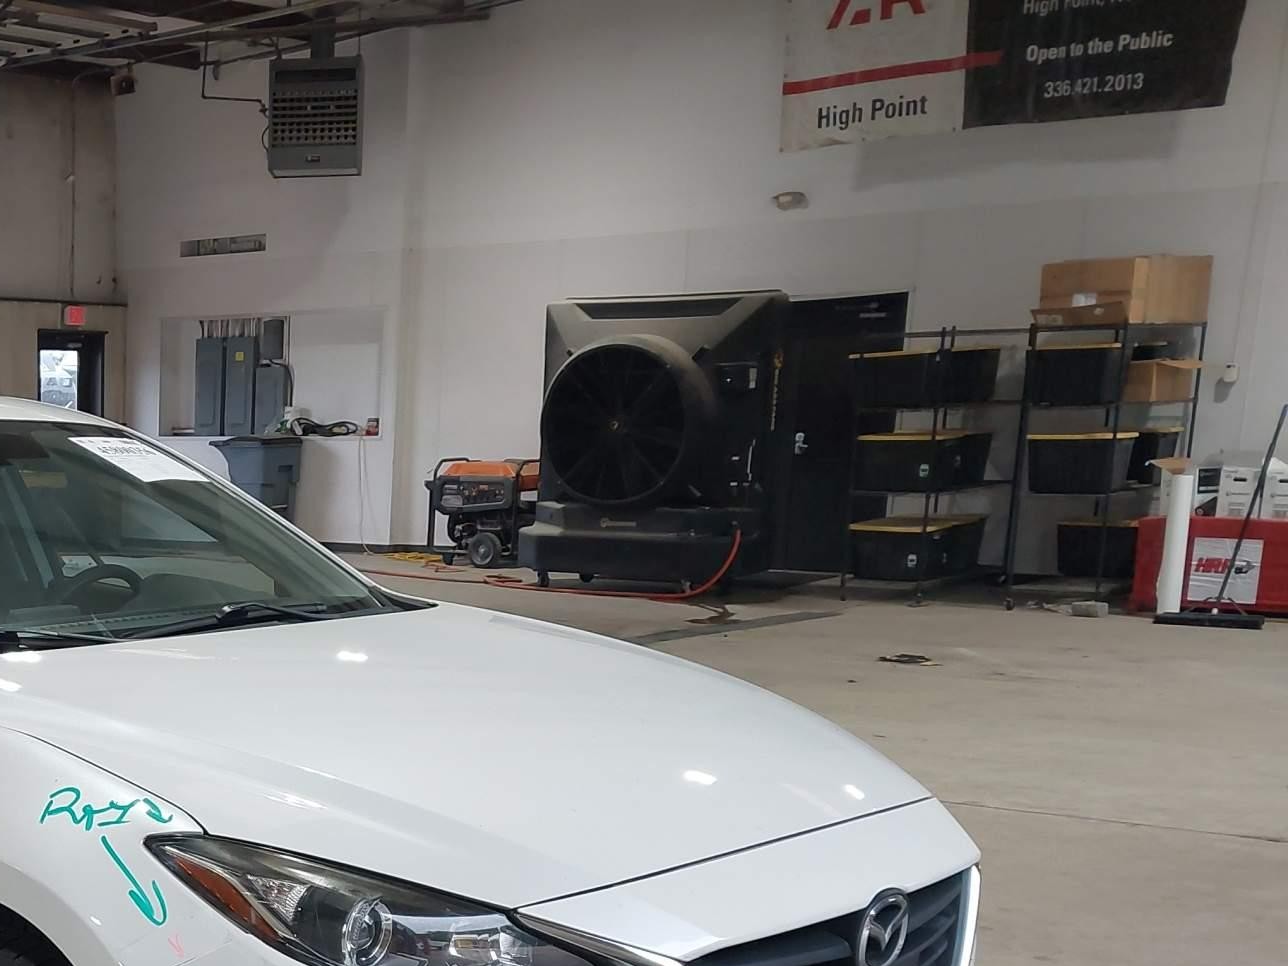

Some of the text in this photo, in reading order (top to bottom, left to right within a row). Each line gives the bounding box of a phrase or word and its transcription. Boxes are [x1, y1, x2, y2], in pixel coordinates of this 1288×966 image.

[1023, 0, 1059, 16] High
[1026, 30, 1173, 64] Open to the Public
[1044, 73, 1145, 98] 336.421.2013
[817, 95, 929, 130] High Point
